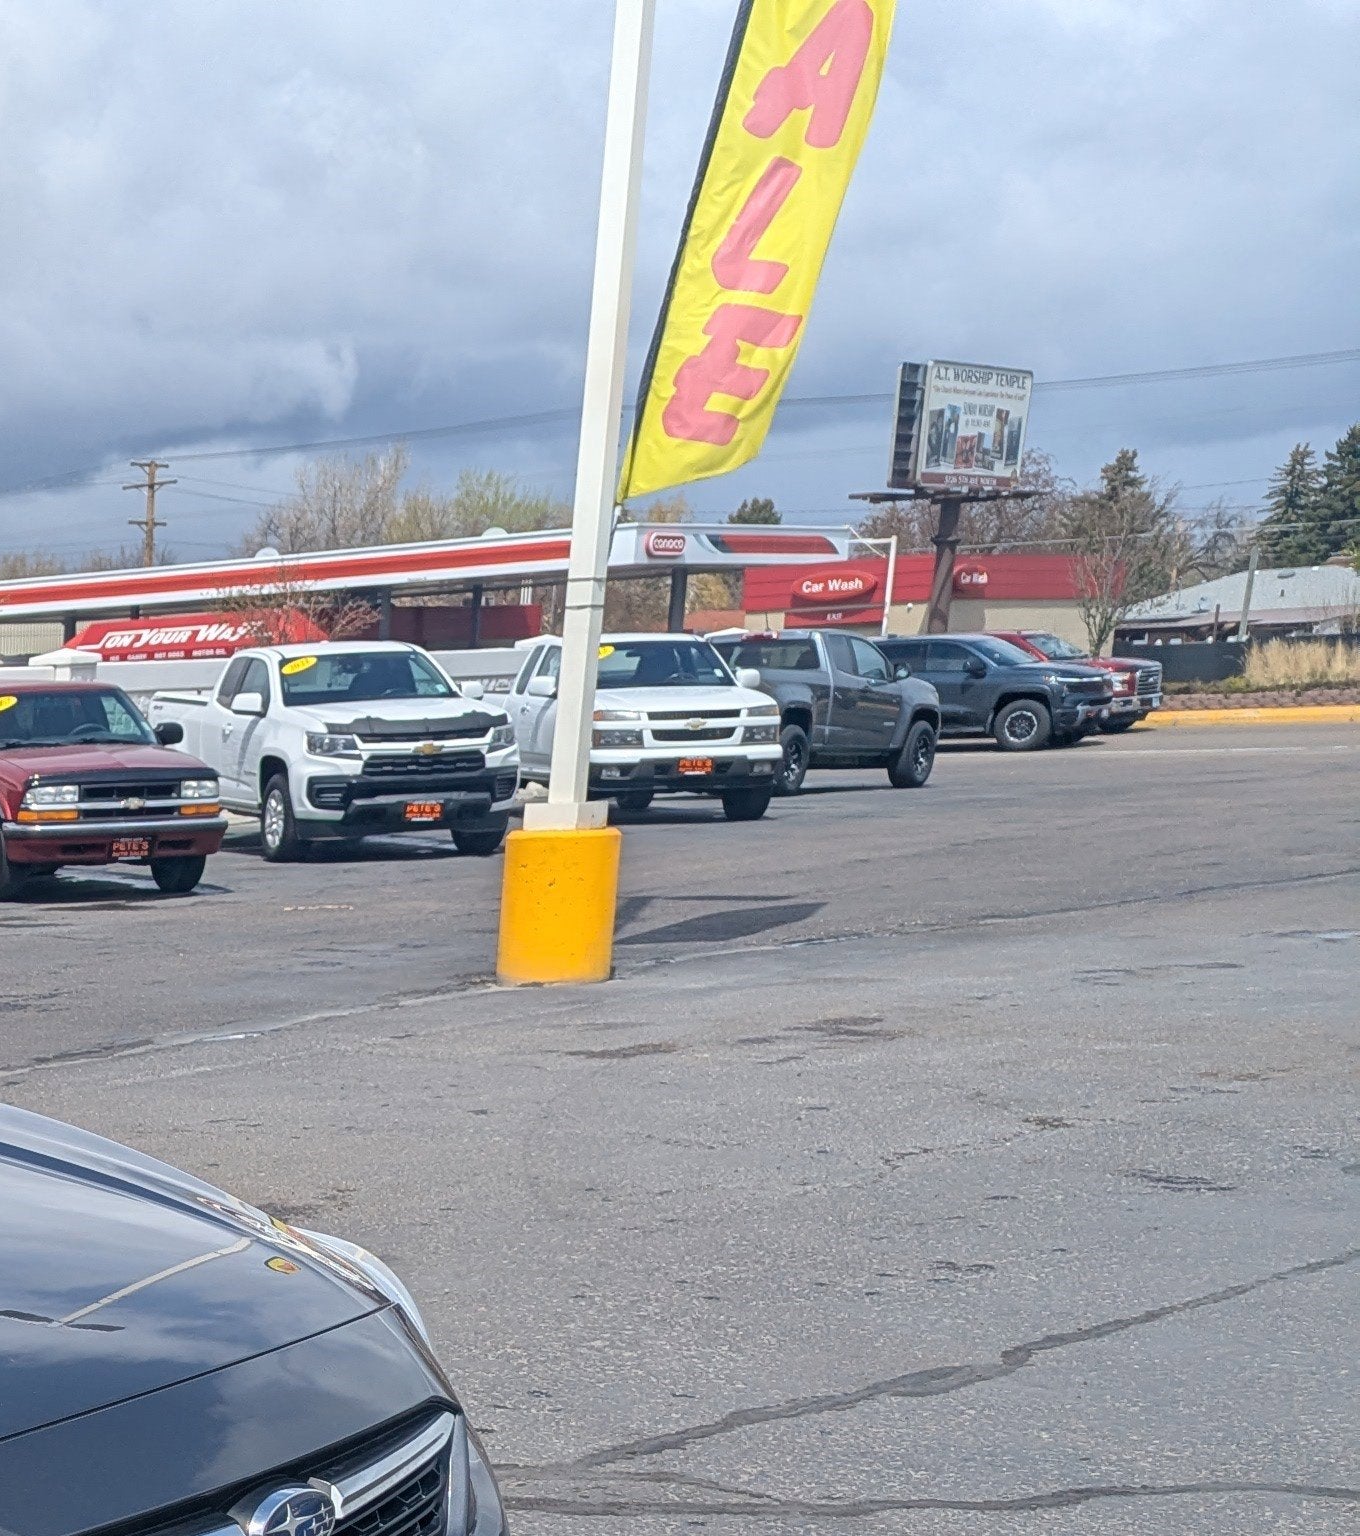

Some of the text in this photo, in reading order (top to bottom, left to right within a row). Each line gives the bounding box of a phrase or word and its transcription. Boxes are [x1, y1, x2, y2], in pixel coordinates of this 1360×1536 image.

[953, 368, 994, 386] WORSHIP
[995, 372, 1027, 390] TEMPLE
[802, 578, 864, 593] Car Wash
